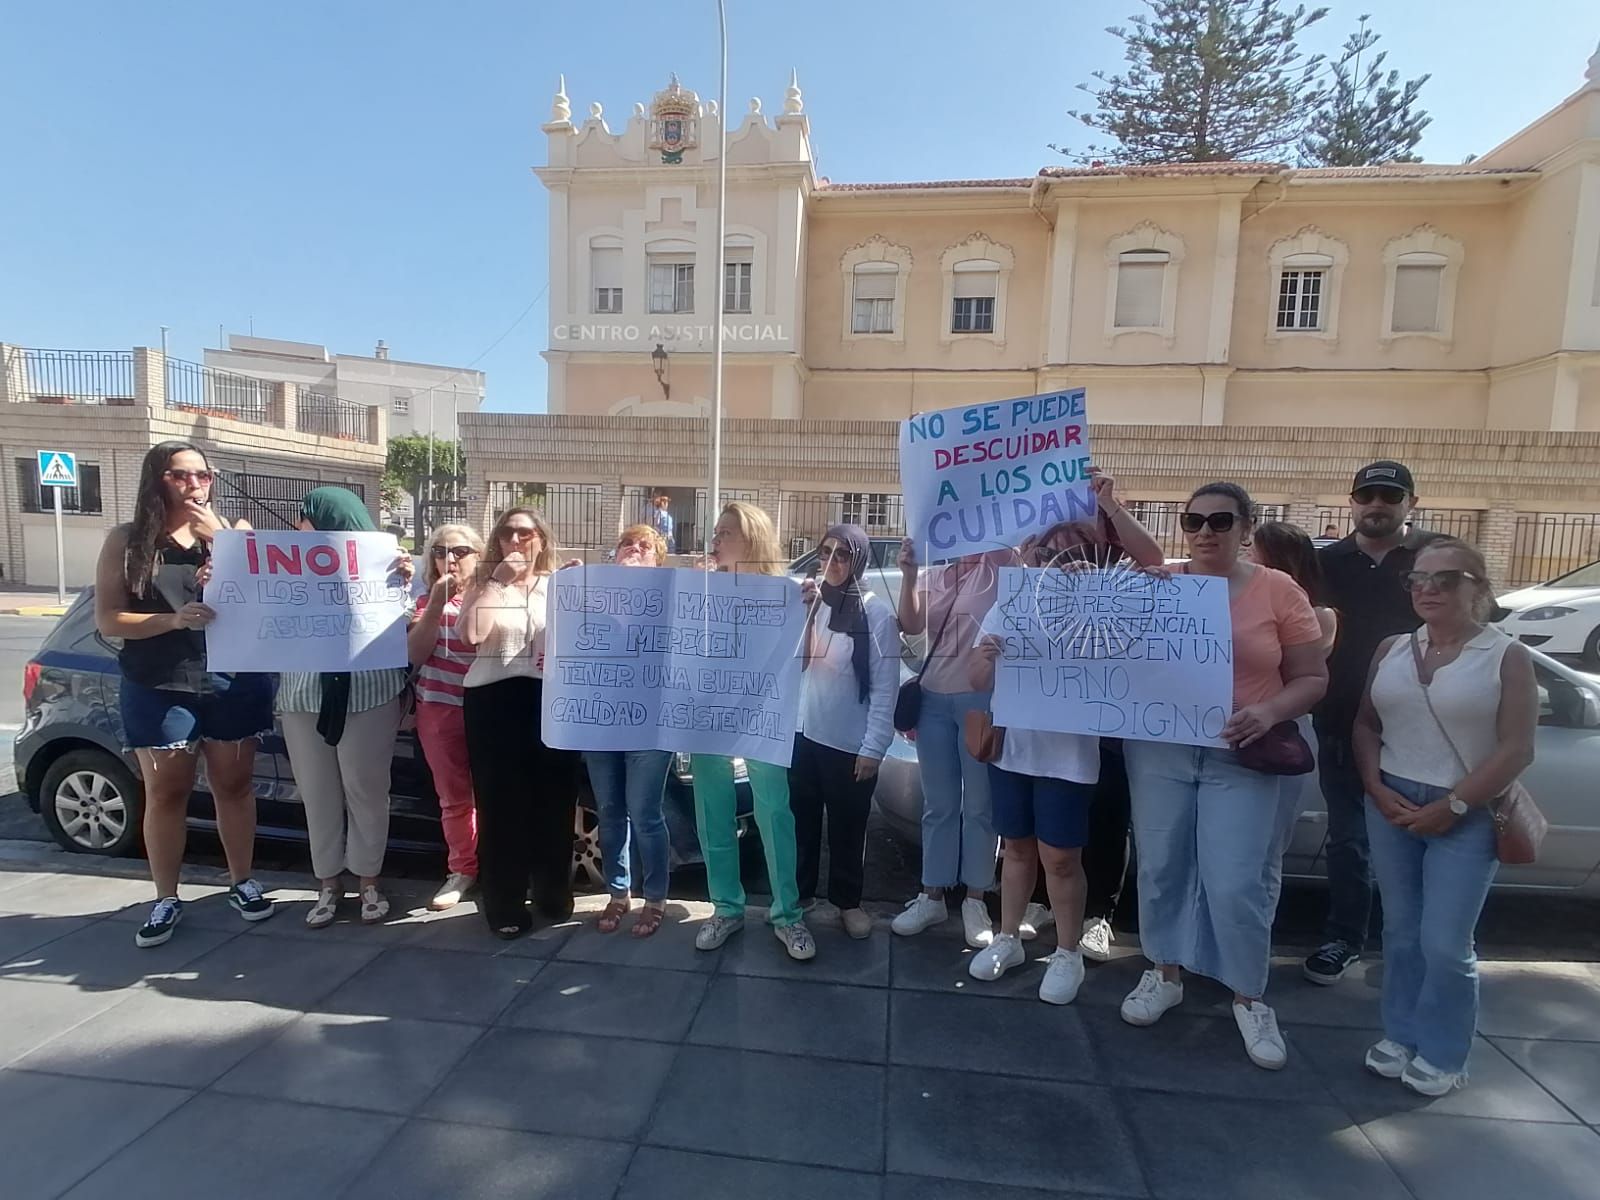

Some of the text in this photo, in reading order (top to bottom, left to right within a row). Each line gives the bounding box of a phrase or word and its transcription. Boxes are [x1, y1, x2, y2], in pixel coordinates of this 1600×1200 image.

[554, 325, 788, 340] CENTRO ASISTNCIAL
[910, 393, 1085, 443] NO SE PUEDE
[937, 457, 1092, 505] A LOS QUE
[246, 532, 360, 580] ¡NO!
[217, 579, 404, 605] A LOS TURNOS
[1008, 573, 1209, 597] LAS ENFERMERAS Y
[555, 585, 786, 626] NUESTROS MAYORES
[1006, 595, 1189, 614] AUXILIARES DEL
[257, 613, 379, 640] ABUSIVOS
[575, 623, 747, 659] SE MERECEN
[1002, 615, 1215, 635] CENTRO ASISTENCIAL
[1004, 636, 1231, 664] SE MERECEN UN
[559, 661, 780, 699] TENER UNA BUENA
[1003, 665, 1130, 700] TURNO
[1083, 700, 1227, 739] DIGNO
